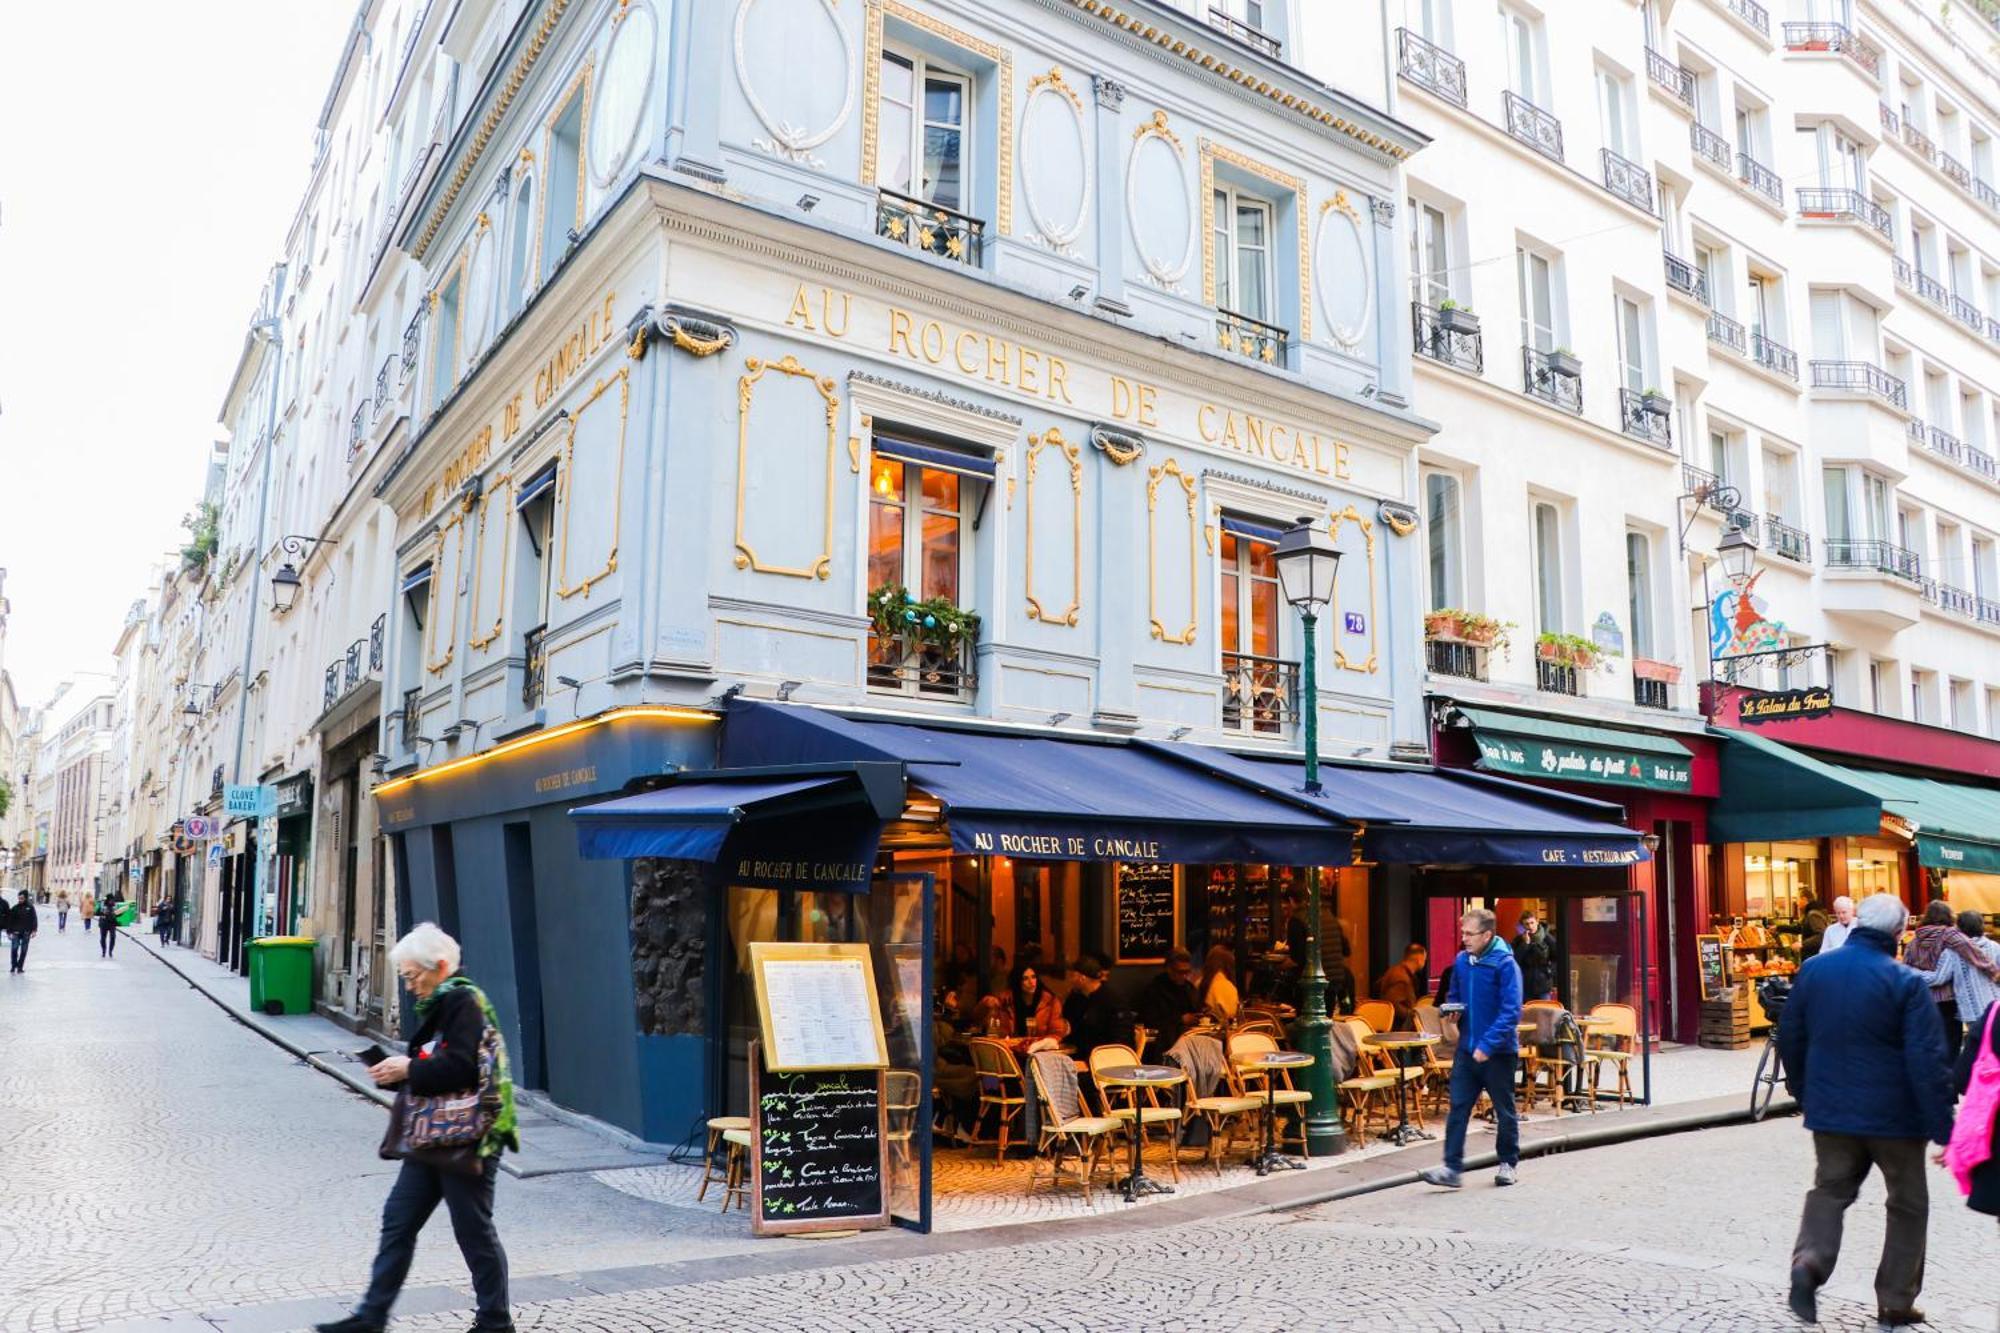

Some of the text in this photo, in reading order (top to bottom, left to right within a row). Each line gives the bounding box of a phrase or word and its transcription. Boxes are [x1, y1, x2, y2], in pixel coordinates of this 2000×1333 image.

[504, 394, 522, 443] DE
[535, 291, 616, 409] CANCALE
[784, 283, 1351, 481] AU ROCHER DE CANCALE
[1348, 614, 1363, 632] 78
[1741, 692, 1830, 717] Le Palais du Fruit
[1589, 756, 1604, 773] du
[231, 790, 254, 800] CLOVE
[228, 800, 257, 811] BAKERY
[975, 832, 1160, 859] AU ROCHER DE CANCALE
[1582, 850, 1640, 863] RESTAURANT
[738, 860, 866, 882] AU ROCHER DE CANCALE
